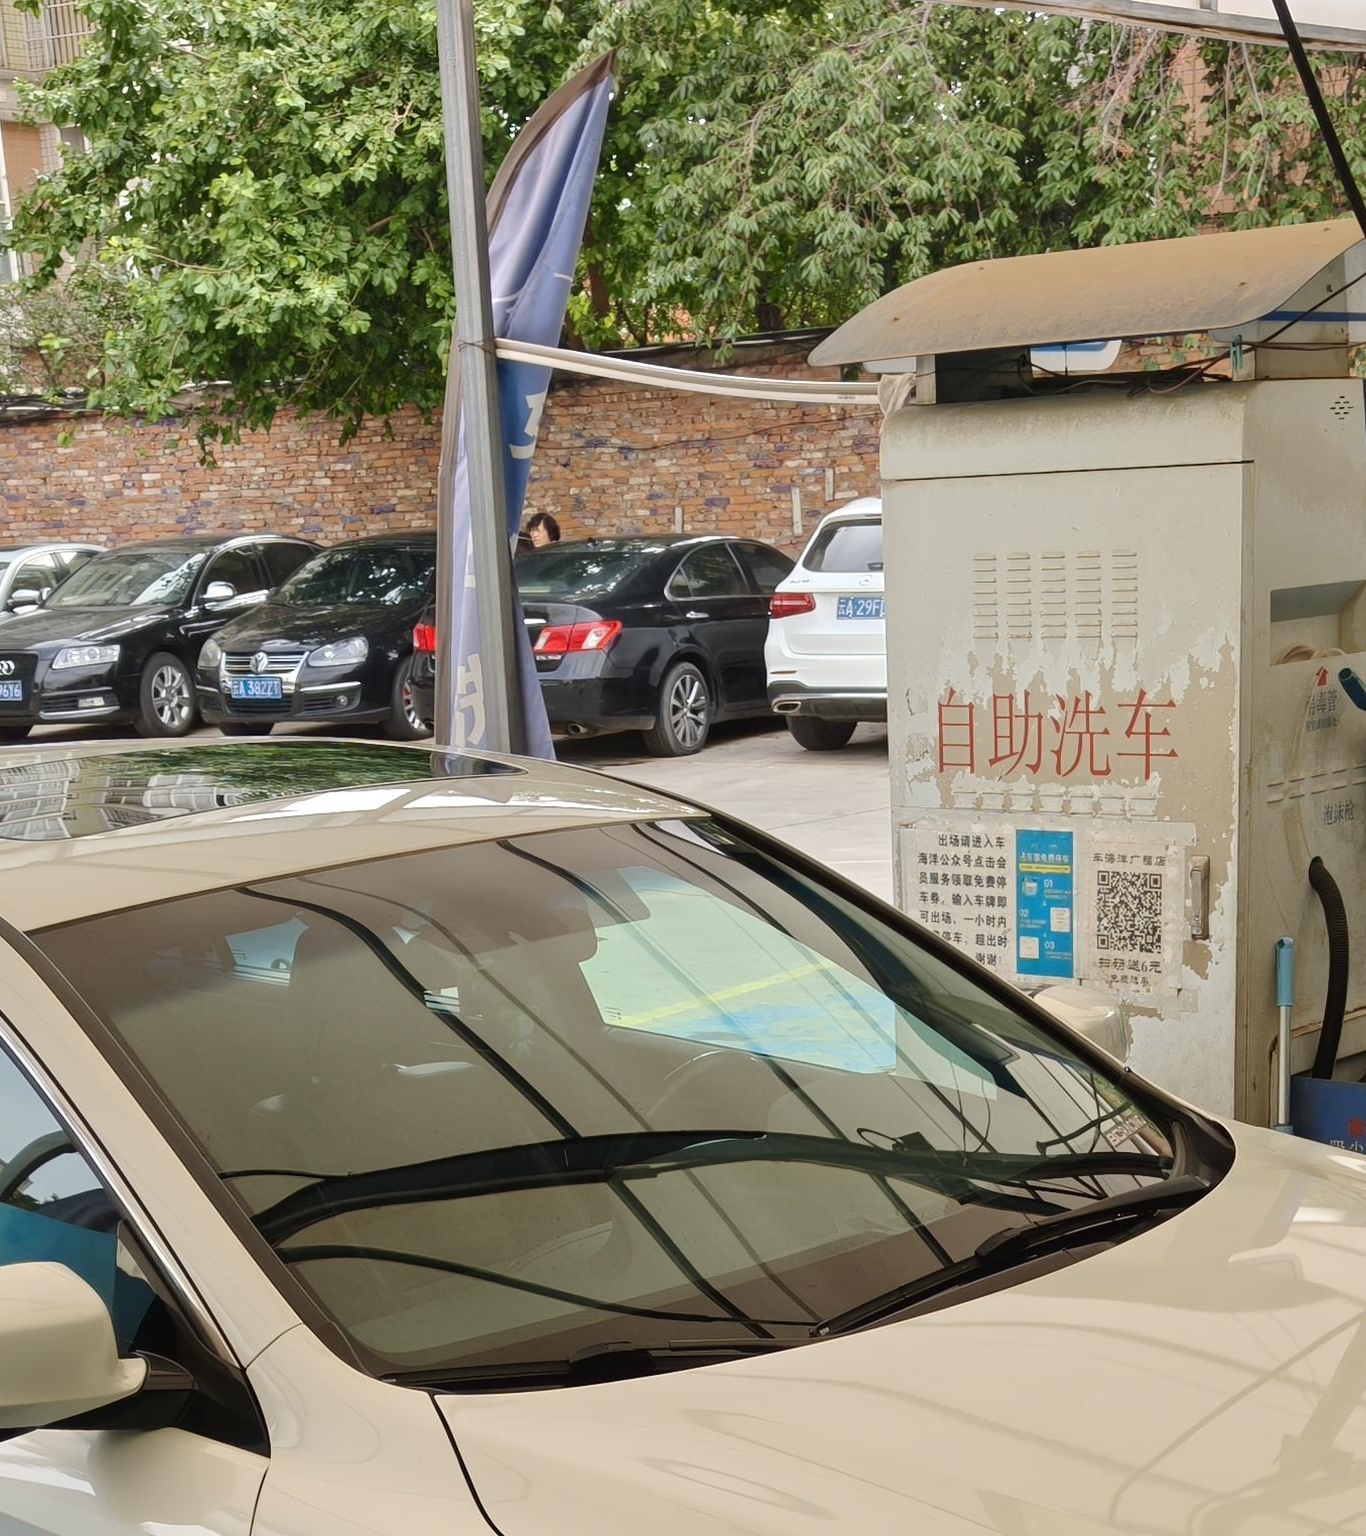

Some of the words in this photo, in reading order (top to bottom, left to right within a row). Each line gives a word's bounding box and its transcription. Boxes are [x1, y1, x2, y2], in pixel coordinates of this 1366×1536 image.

[937, 687, 1179, 781] 自助洗车
[938, 834, 1006, 849] 出场请进入车
[917, 852, 1007, 869] 海洋公众号点击会
[918, 872, 1008, 889] 员服务领取免费停
[920, 910, 1008, 928] 可出场，一小时内
